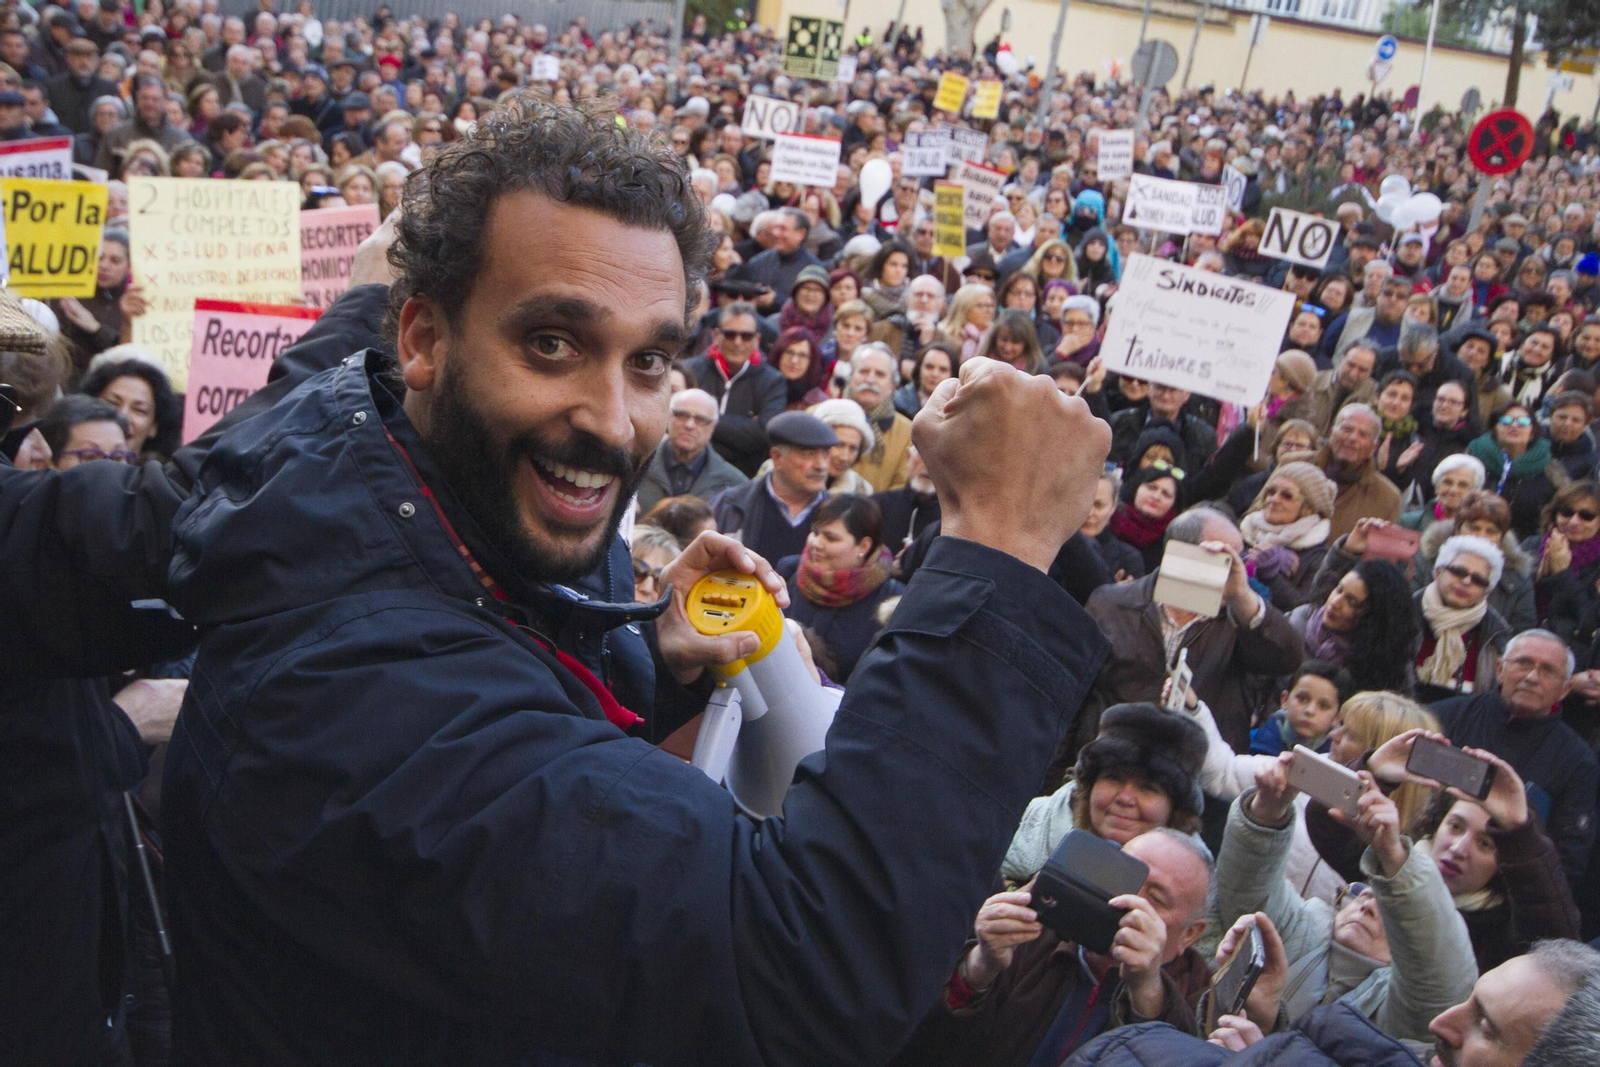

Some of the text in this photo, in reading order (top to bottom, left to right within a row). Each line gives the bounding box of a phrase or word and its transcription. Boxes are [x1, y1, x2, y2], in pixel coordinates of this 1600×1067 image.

[746, 100, 792, 133] NO
[75, 193, 100, 225] la
[138, 183, 293, 216] 2 HOSPITALES
[1151, 187, 1192, 206] SANIDAD
[170, 213, 291, 237] COMPLETOS
[1263, 212, 1333, 260] NO
[7, 243, 97, 275] ALUD!
[166, 240, 228, 260] SALUD
[236, 240, 289, 260] DIGNA
[236, 268, 298, 285] DERECHOS
[202, 317, 302, 359] Recorta
